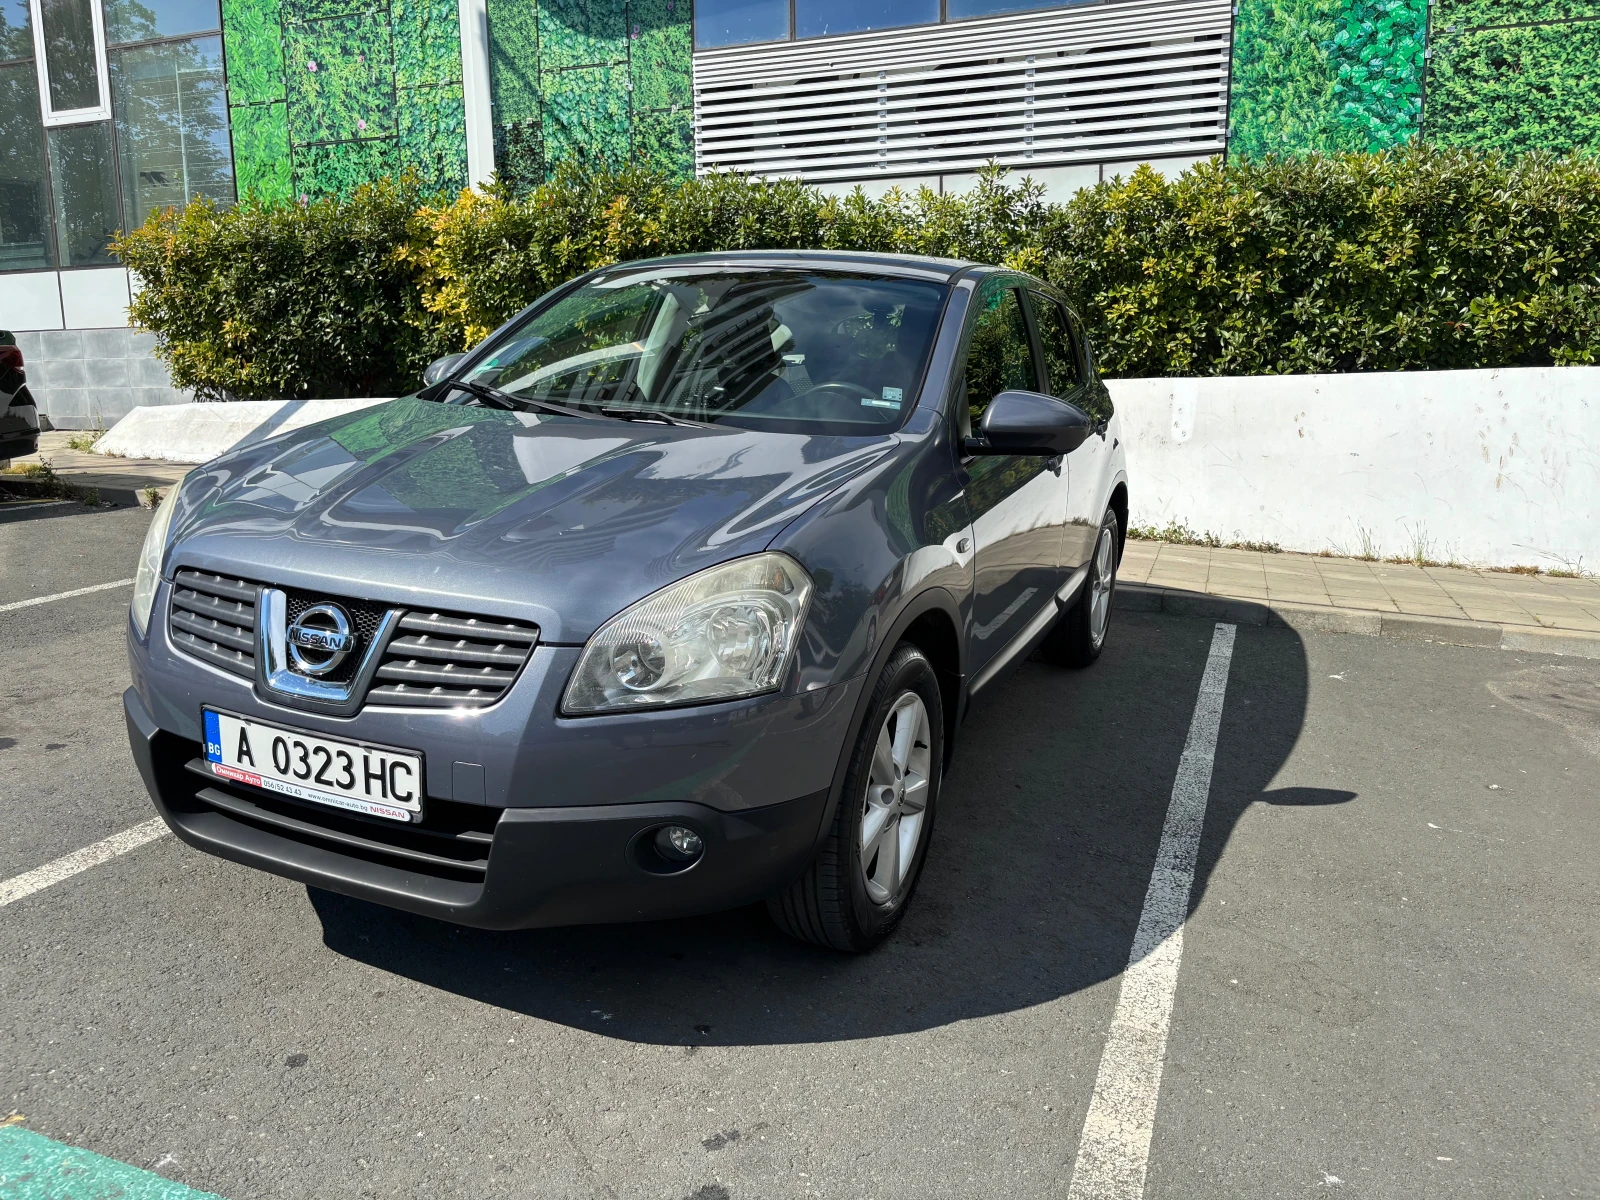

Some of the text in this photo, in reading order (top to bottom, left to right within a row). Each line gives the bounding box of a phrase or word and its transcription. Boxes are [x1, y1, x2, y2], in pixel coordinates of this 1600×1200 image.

[289, 628, 342, 648] NISSAN
[208, 742, 221, 756] BG
[237, 726, 413, 803] A 0323 HC
[245, 775, 261, 785] Ауто
[369, 806, 405, 819] NISSAN
